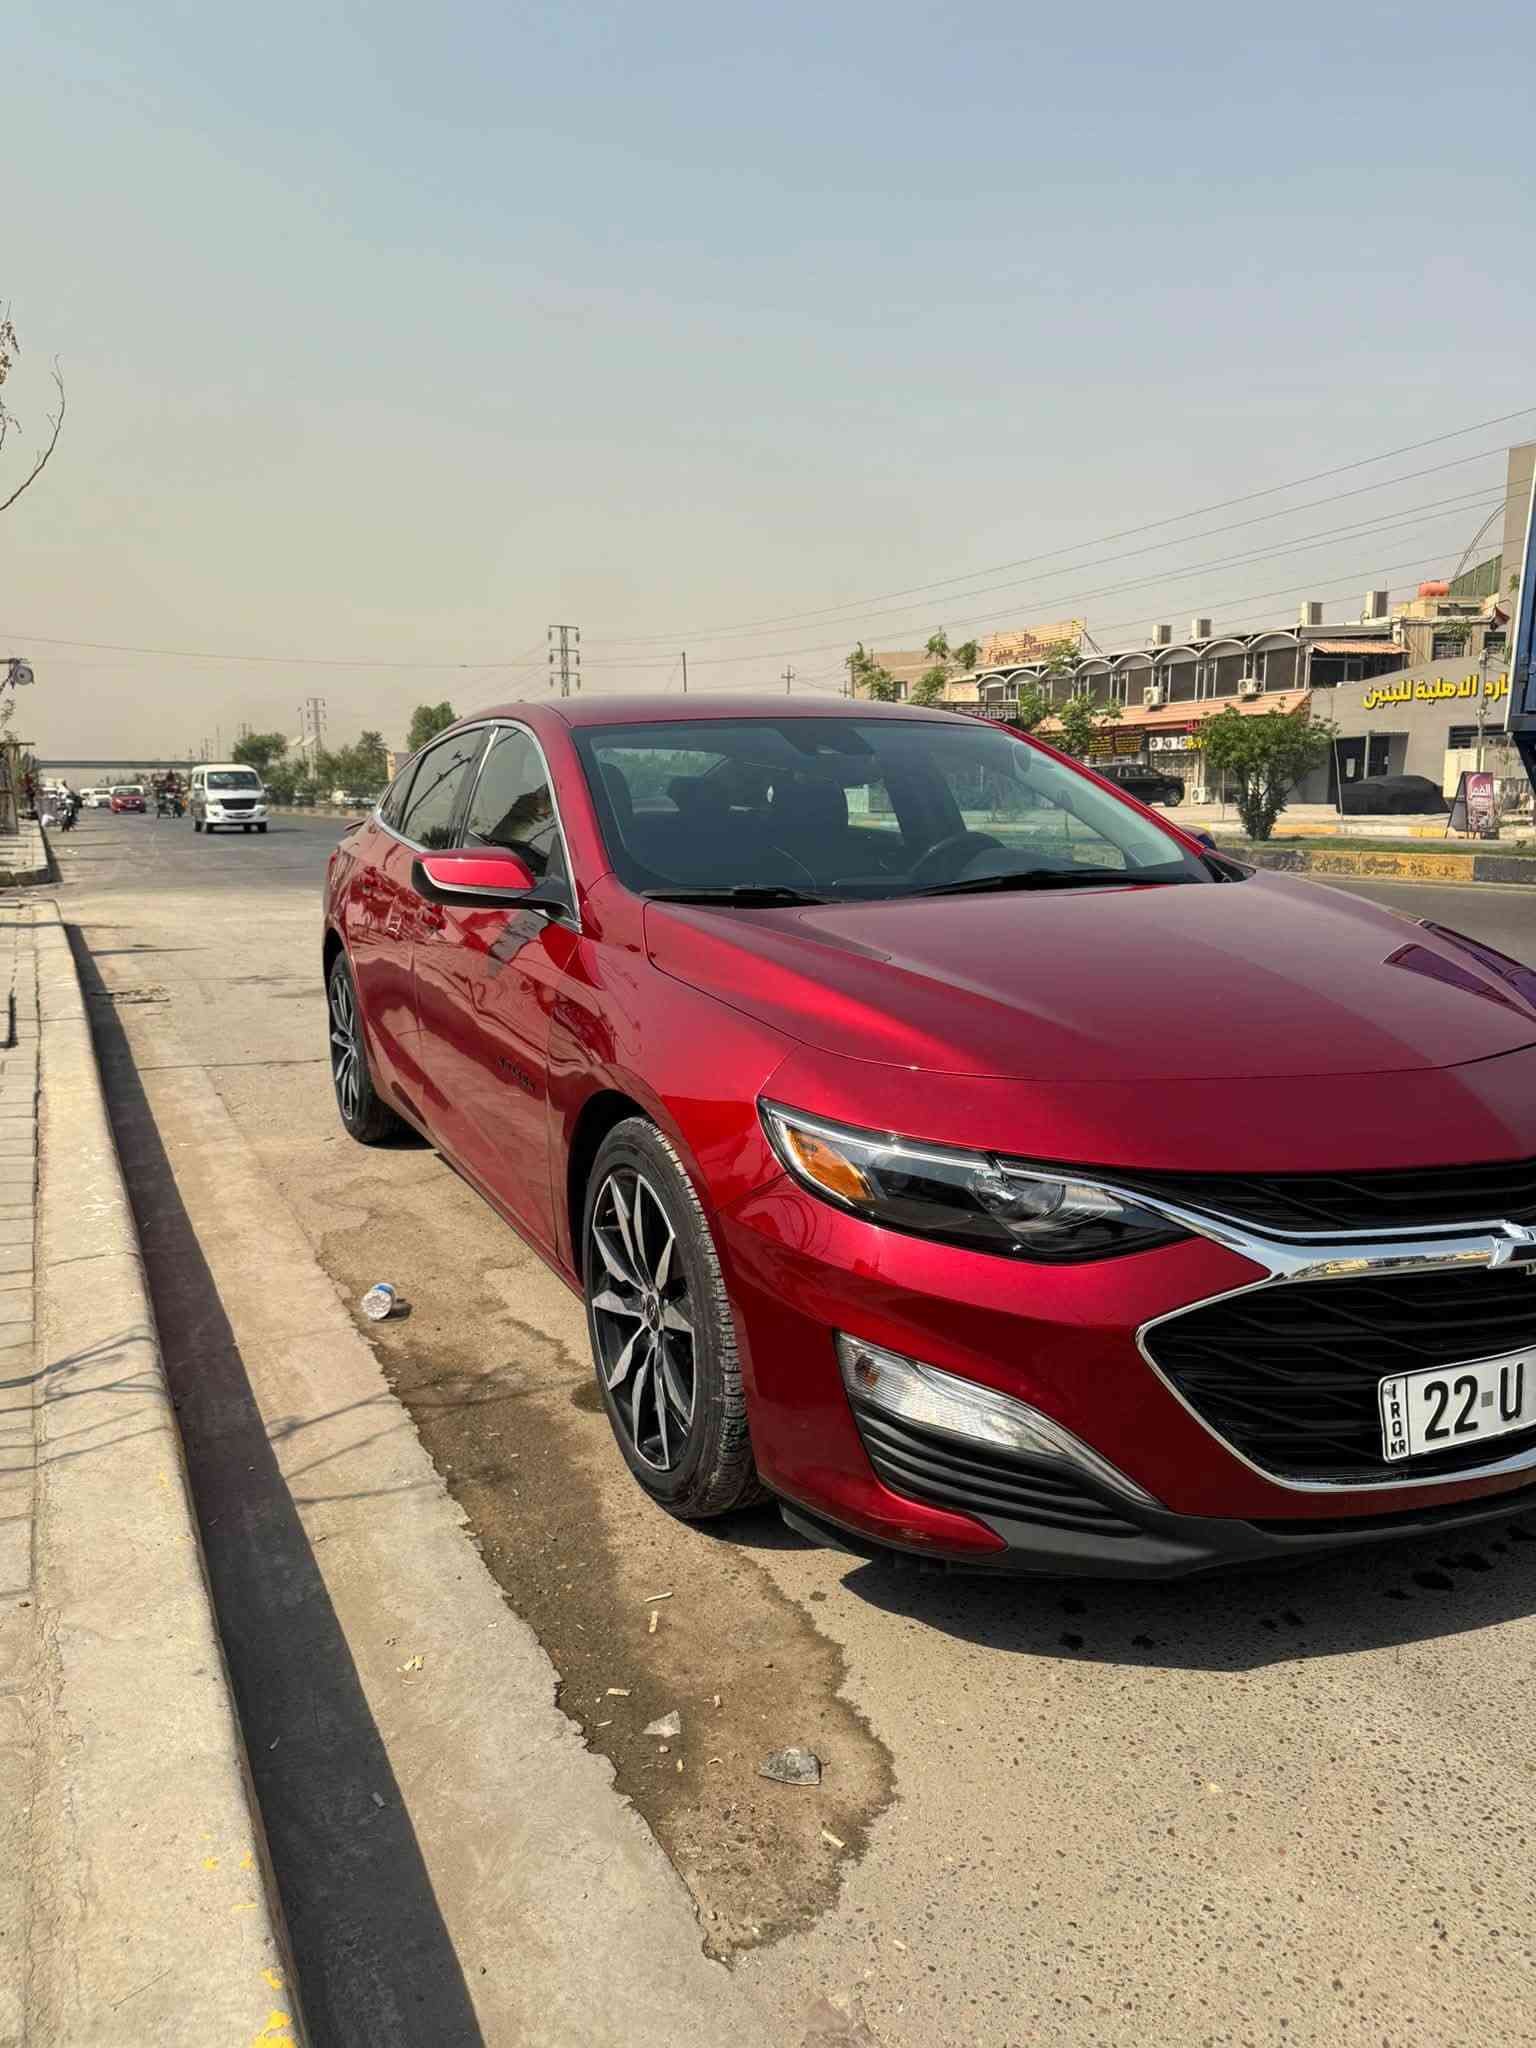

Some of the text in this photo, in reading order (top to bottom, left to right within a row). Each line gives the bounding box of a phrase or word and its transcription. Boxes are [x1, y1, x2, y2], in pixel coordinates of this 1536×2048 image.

[1362, 679, 1414, 709] للبنين
[1415, 673, 1479, 706] الاهلية
[1390, 1439, 1406, 1455] KR
